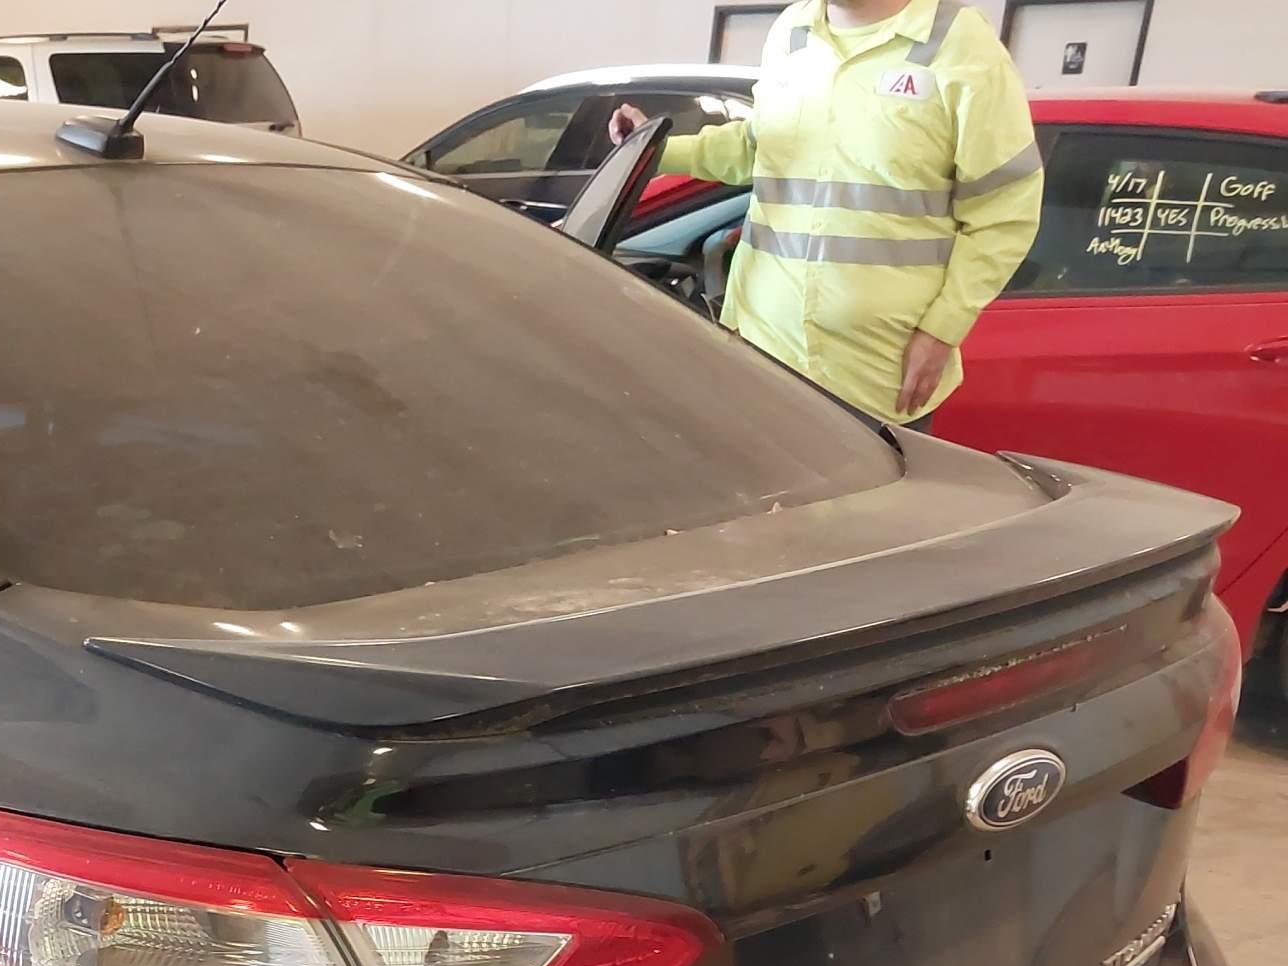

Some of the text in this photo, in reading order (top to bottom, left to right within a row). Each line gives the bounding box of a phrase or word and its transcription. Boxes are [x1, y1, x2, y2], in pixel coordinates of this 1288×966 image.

[1107, 172, 1147, 194] 4/17
[1220, 176, 1277, 201] Goff
[1097, 207, 1145, 228] 11423
[997, 769, 1049, 818] Ford
